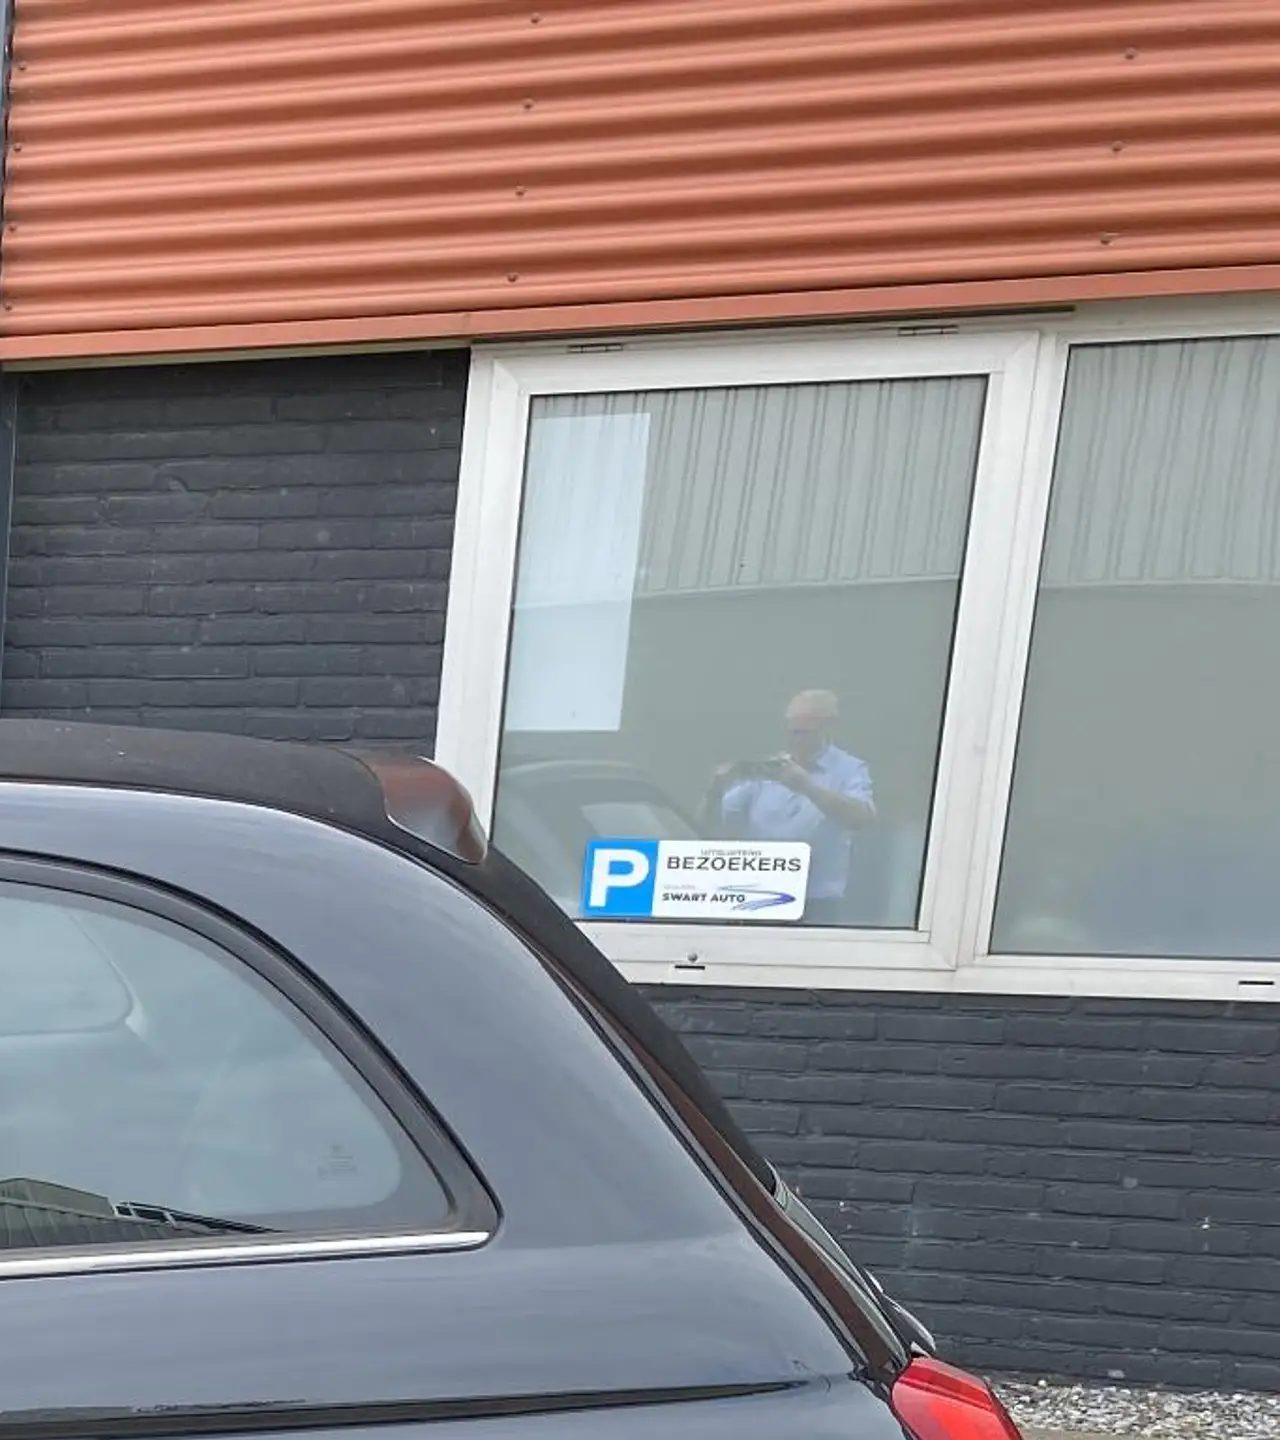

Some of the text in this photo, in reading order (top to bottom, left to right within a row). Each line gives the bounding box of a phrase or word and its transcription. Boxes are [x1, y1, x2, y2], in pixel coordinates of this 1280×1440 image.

[666, 856, 802, 872] BEZOEKERS
[588, 848, 650, 907] P
[662, 892, 746, 903] SWART AUTO
